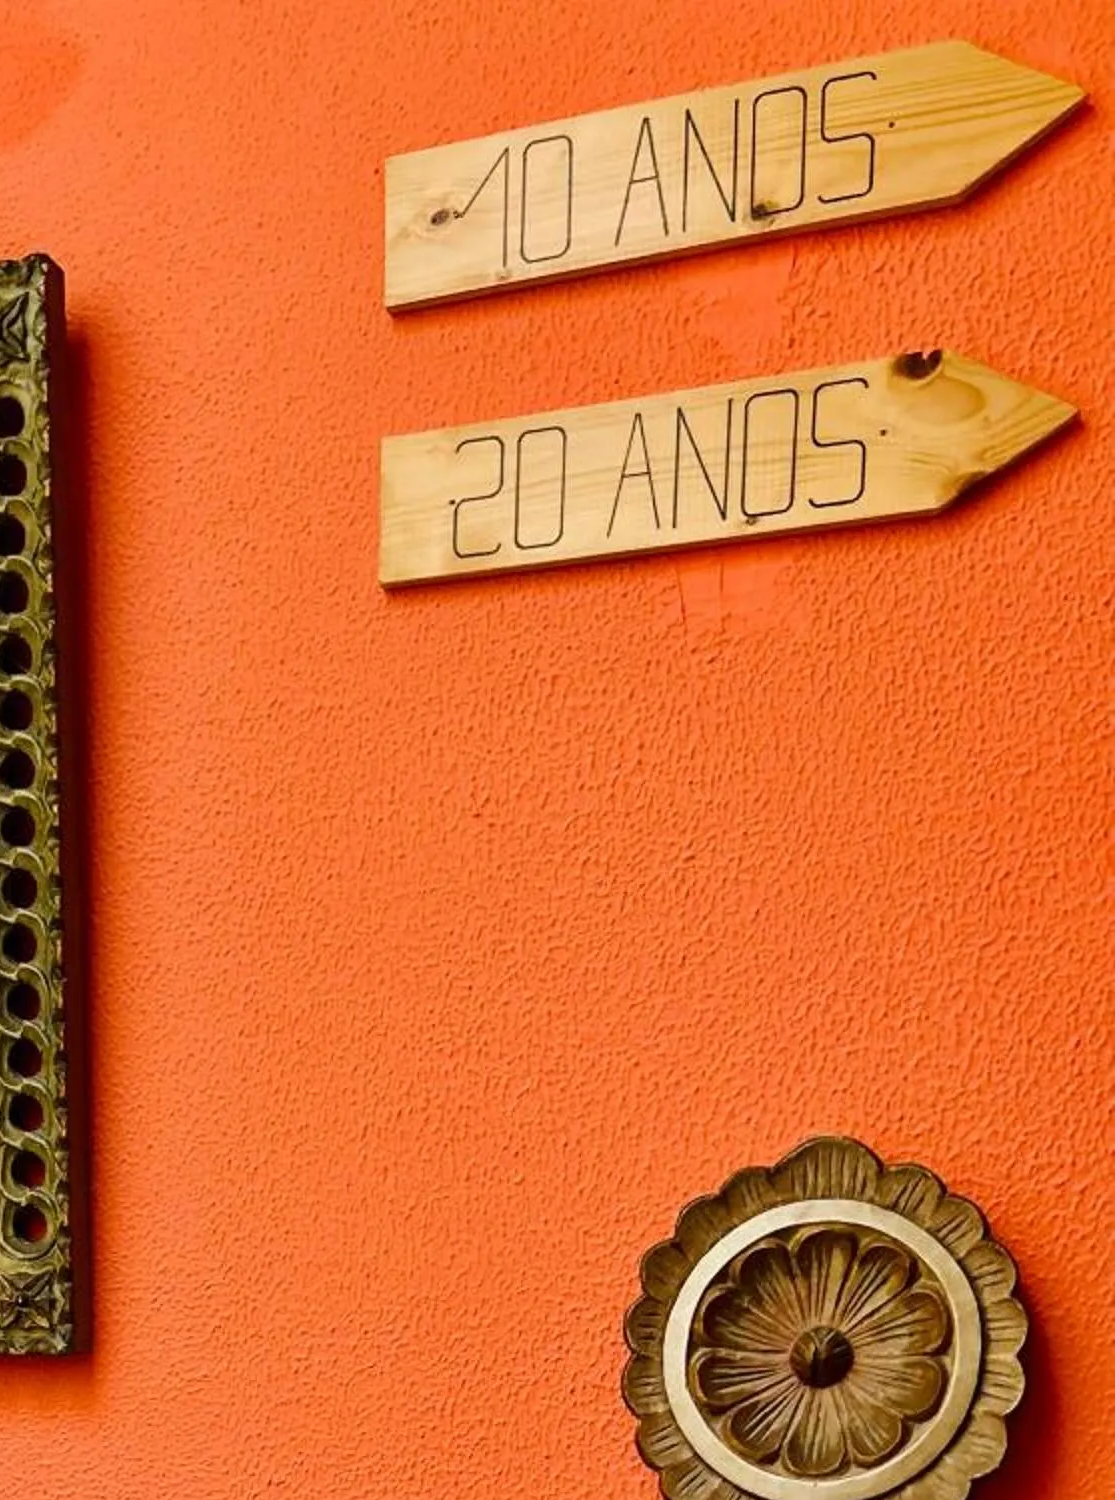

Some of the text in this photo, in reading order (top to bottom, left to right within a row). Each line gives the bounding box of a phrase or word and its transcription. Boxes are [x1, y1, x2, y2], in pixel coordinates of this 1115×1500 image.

[455, 71, 878, 268] 10 ANOS
[451, 377, 870, 559] 20 ANOS
